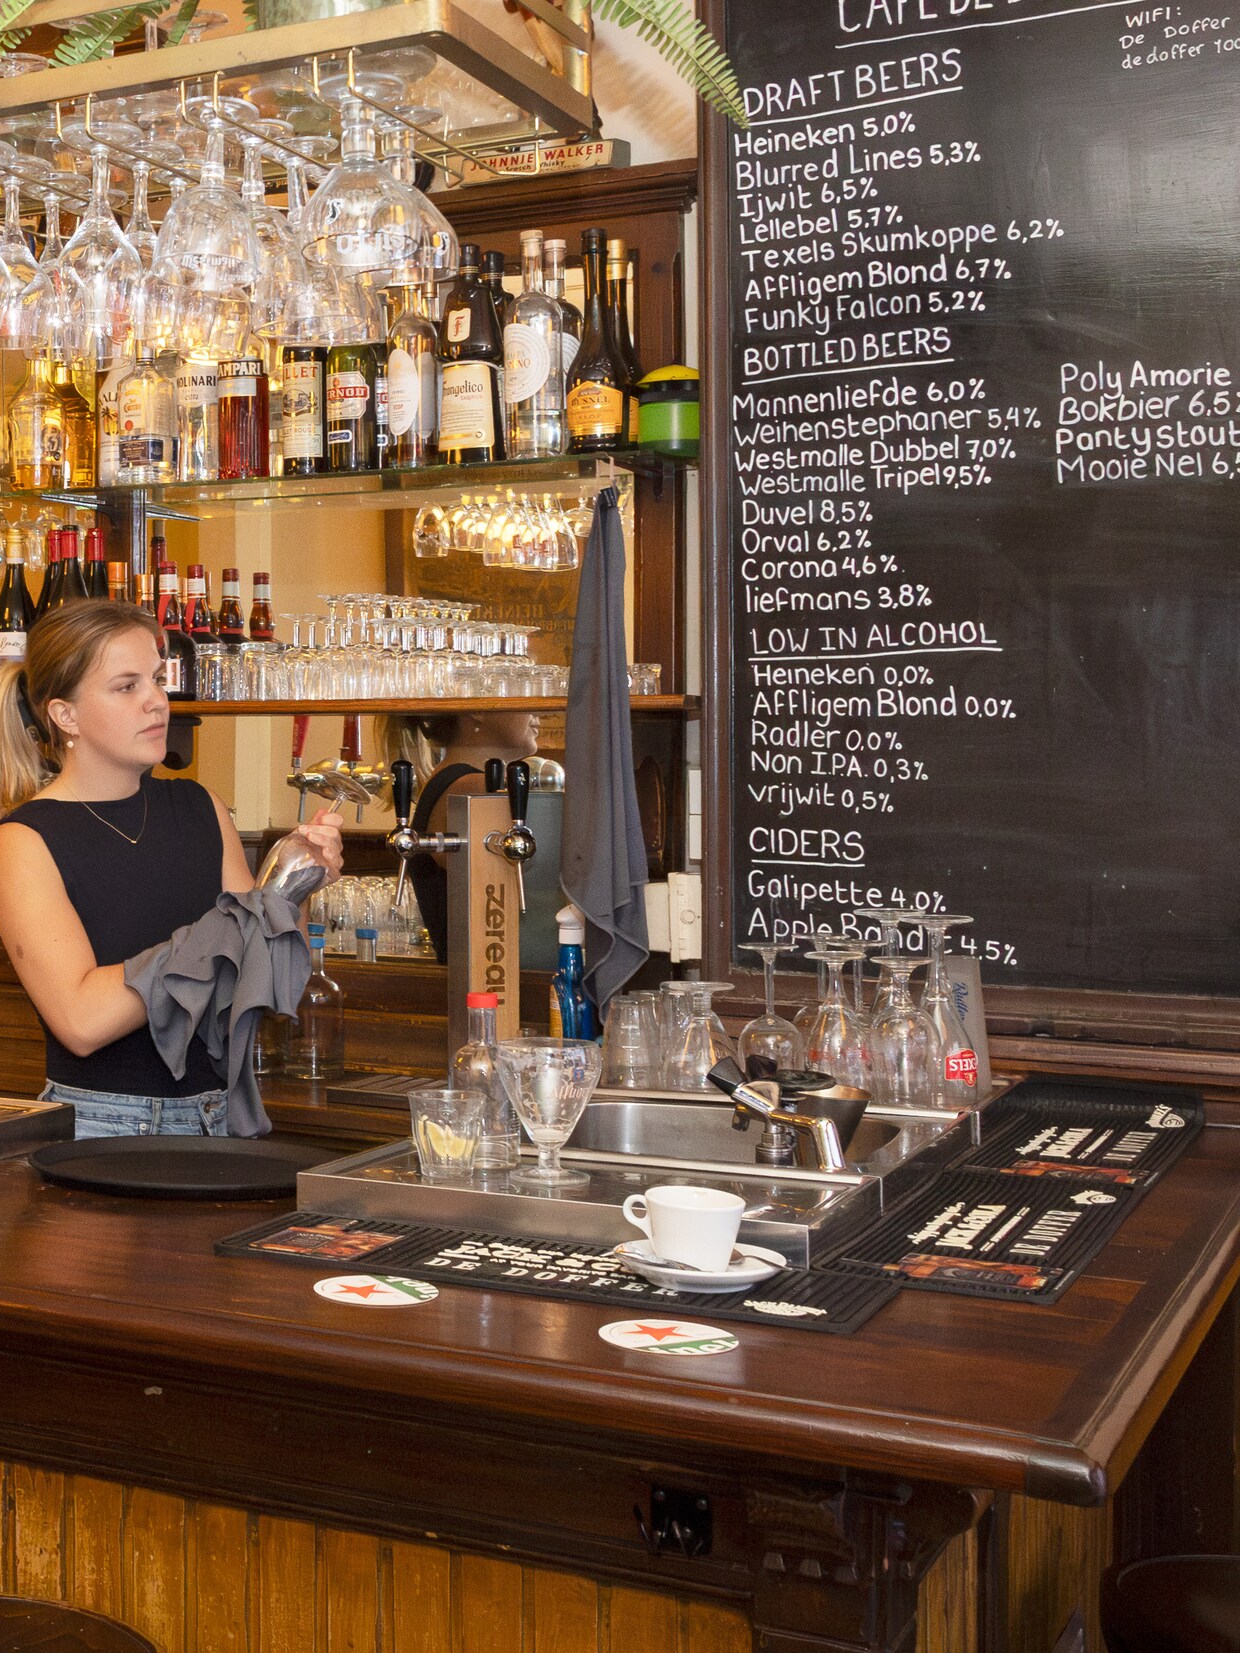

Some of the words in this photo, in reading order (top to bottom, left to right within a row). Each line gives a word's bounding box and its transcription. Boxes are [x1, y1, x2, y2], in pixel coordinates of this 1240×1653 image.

[1119, 34, 1145, 50] De
[1163, 16, 1231, 39] Doffer
[743, 69, 845, 117] DRAFT
[855, 48, 962, 98] BEERS
[544, 143, 604, 161] WALKER
[734, 123, 855, 157] Heineken
[735, 148, 838, 190] Blurred
[849, 143, 922, 175] Lines
[929, 141, 981, 167] 5,3%
[737, 184, 812, 222] Ijwit
[820, 177, 878, 203] 6,5%
[739, 208, 838, 245] Lellebel
[741, 240, 835, 272] Texels
[841, 224, 998, 257] Skumkoppe
[1006, 218, 1065, 244] 6,2%
[745, 269, 862, 305] Affligem
[867, 253, 948, 288] Blond
[954, 258, 1012, 283] 6,7%
[745, 300, 830, 335] Funky
[836, 293, 922, 321] Falcon
[744, 336, 857, 376] BOTTLED
[862, 326, 952, 362] BEERS
[1061, 360, 1122, 399] Poly
[1130, 360, 1232, 388] Amorie
[732, 376, 917, 421] Mannenliefde
[926, 378, 986, 404] 6,0%
[1059, 391, 1180, 425] Bokbier
[1188, 390, 1240, 417] 6,5
[734, 407, 982, 447] Weihenstephaner
[987, 407, 1042, 431] 5,4%
[1056, 426, 1151, 456] Panty
[734, 443, 865, 472] Westmalle
[869, 434, 960, 465] Dubbel
[965, 437, 1017, 462] 7,0%
[1057, 454, 1147, 484] Mooie
[1155, 452, 1202, 477] Nel
[738, 468, 867, 496] Westmalle
[870, 463, 940, 495] Tripel
[942, 465, 993, 490] 9,5%
[741, 499, 813, 526] Duvel
[819, 499, 874, 525] 8,5%
[741, 527, 810, 554] Orval
[816, 528, 872, 554] 6,2%
[741, 558, 837, 581] Corona
[841, 554, 899, 578] 4,6%
[745, 584, 871, 613] liefmans
[877, 584, 933, 610] 3,8%
[751, 627, 810, 655] LOW
[817, 626, 857, 651] IN
[866, 621, 998, 648] ALCOHOL
[752, 663, 875, 686] Heineken
[883, 665, 935, 687] 0,0%
[752, 689, 871, 727] Affligem
[876, 685, 957, 718] Blond
[750, 720, 840, 748] Radler
[845, 729, 903, 752] 0,0%
[750, 750, 803, 775] Non
[873, 758, 929, 783] 0,3%
[841, 789, 895, 814] 0,5%
[749, 826, 865, 862] CIDERS
[747, 869, 884, 910] Galipette
[747, 906, 834, 950] Apple
[949, 1057, 977, 1072] XELS
[424, 1257, 482, 1271] DE
[501, 1267, 679, 1297] DOFFER
